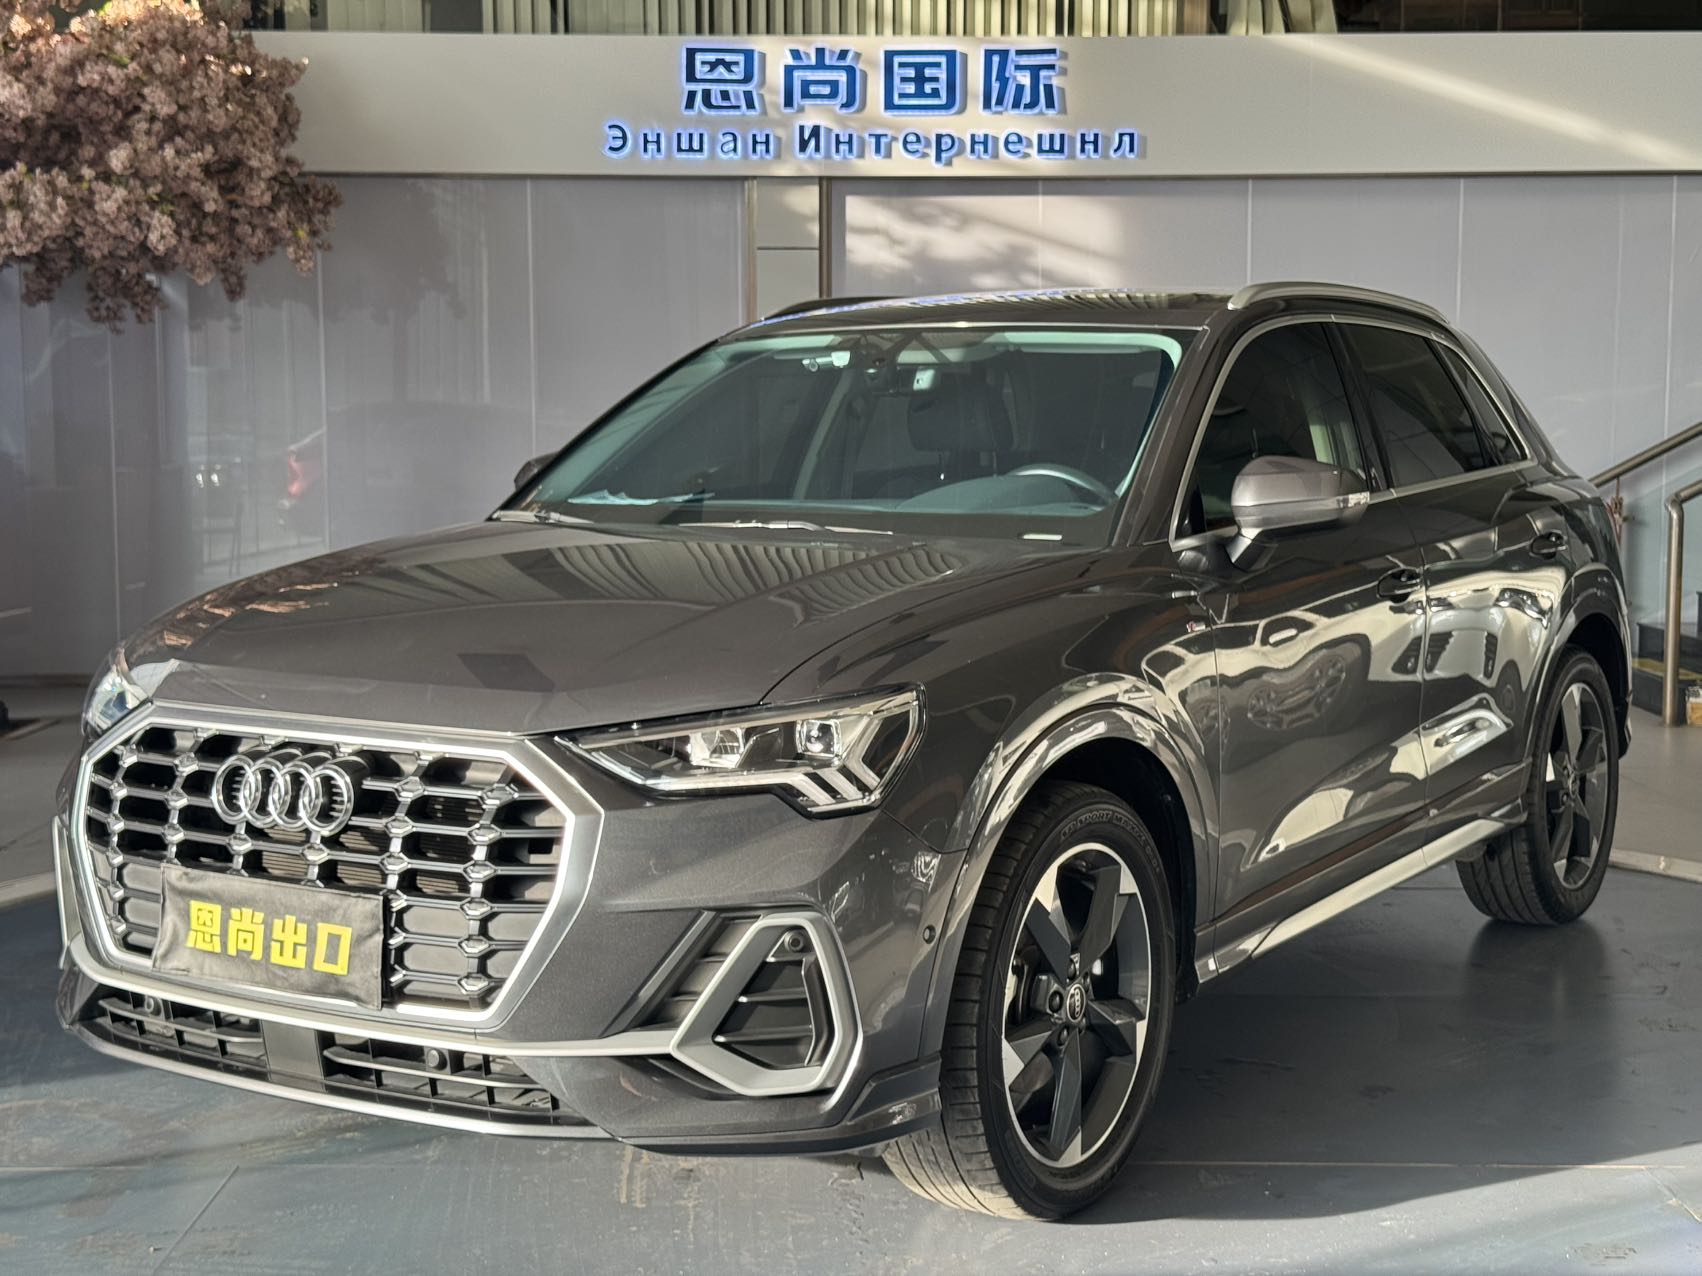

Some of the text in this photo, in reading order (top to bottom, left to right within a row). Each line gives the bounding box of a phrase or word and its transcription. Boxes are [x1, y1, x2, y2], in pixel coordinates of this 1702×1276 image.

[684, 46, 1058, 114] 恩尚国际
[606, 124, 1136, 163] Эншан Интернешнл
[186, 900, 353, 976] 恩尚出口
